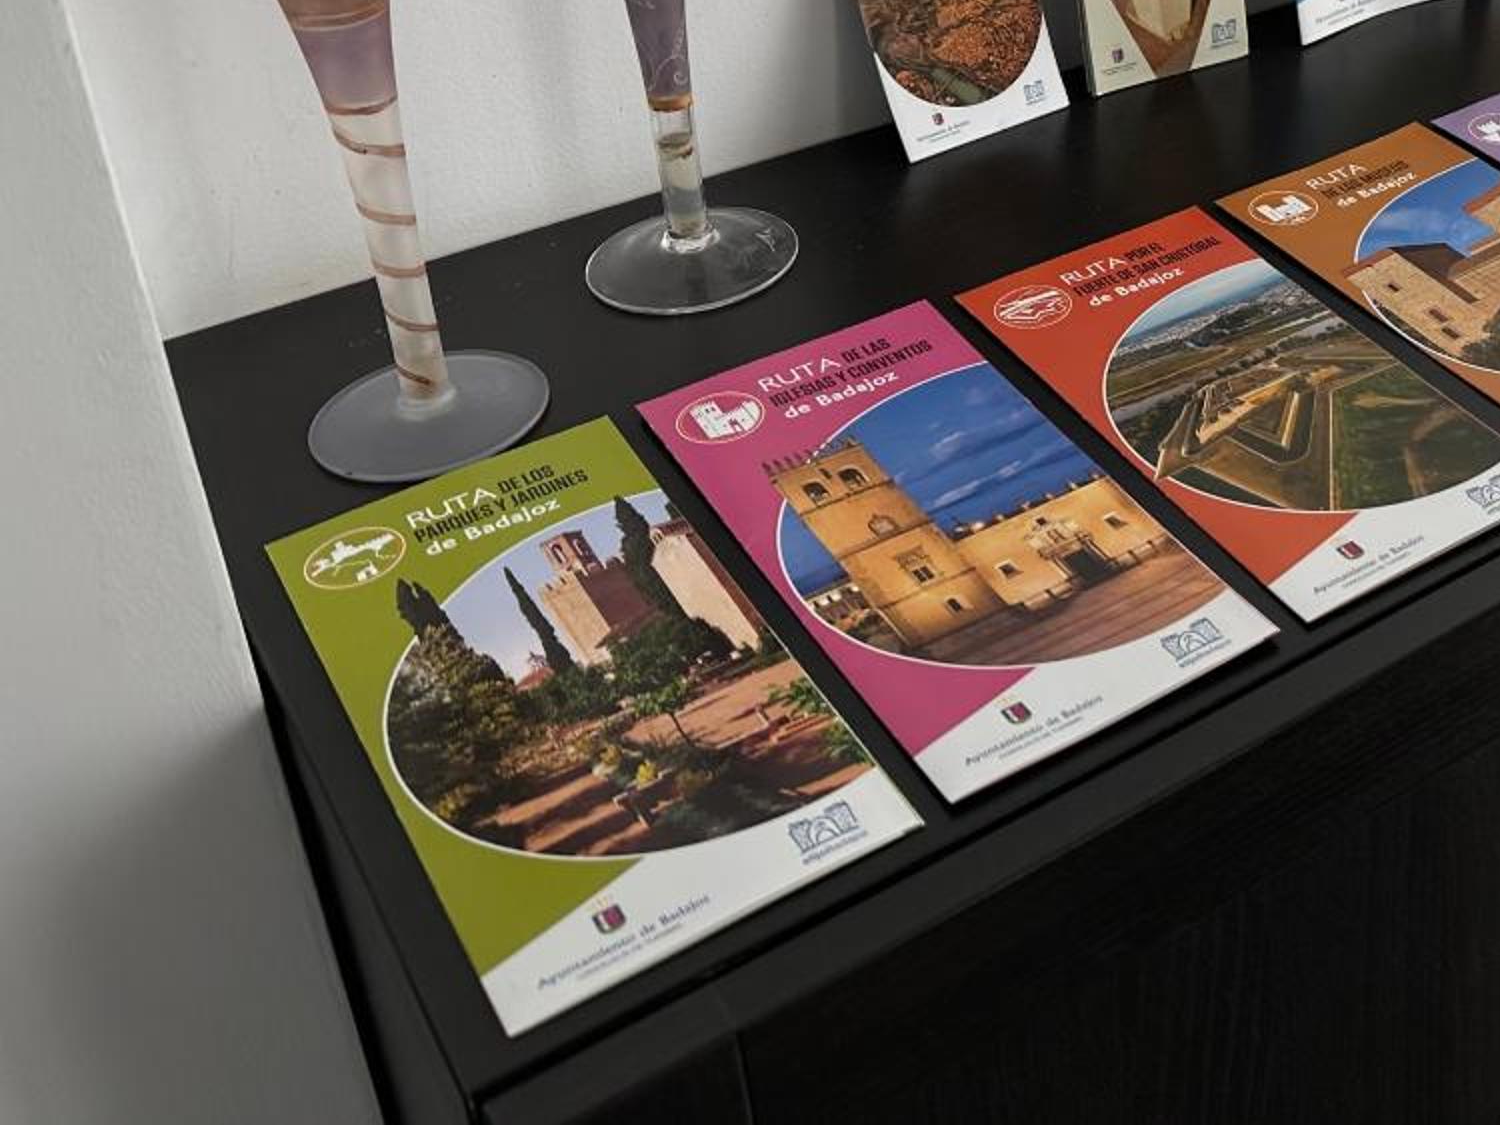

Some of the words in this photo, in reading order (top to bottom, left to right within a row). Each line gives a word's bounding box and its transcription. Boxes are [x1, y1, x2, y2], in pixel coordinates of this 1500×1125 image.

[1306, 163, 1368, 190] RUTA
[1337, 194, 1356, 209] de
[1356, 172, 1418, 199] Badajoz
[1059, 256, 1128, 286] RUTA
[1088, 293, 1114, 308] de
[1114, 267, 1185, 298] Badajoz
[758, 357, 841, 393] RUTA
[841, 345, 861, 363] DE
[861, 338, 892, 356] LAS
[769, 375, 837, 408] IGLESIAS
[837, 369, 848, 385] Y
[847, 340, 933, 378] CONVENTOS
[784, 401, 811, 419] de
[814, 370, 899, 407] Badajoz
[405, 486, 497, 529] RUTA
[497, 474, 521, 494] DE
[521, 464, 555, 487] LOS
[414, 504, 494, 544] PARQUES
[498, 496, 508, 513] Y
[510, 469, 589, 509] JARDINES
[425, 536, 457, 557] de
[463, 498, 561, 541] Badajoz
